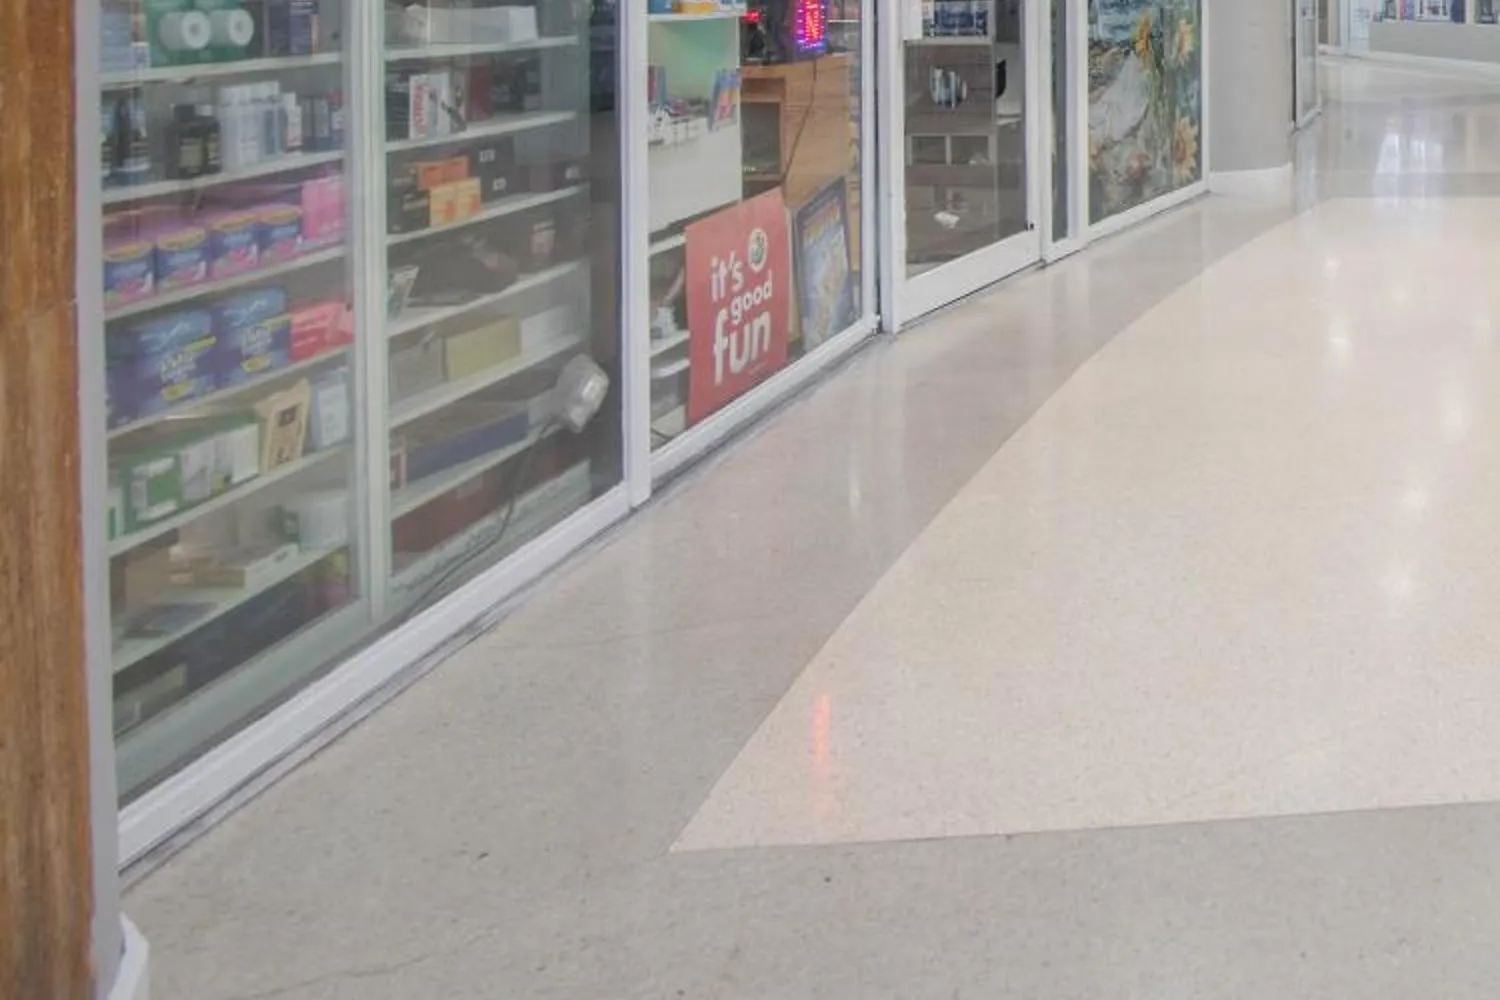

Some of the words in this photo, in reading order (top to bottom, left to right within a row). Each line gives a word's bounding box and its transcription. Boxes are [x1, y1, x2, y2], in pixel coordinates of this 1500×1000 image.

[711, 251, 745, 302] it's
[731, 269, 774, 326] good
[713, 310, 772, 387] fun
